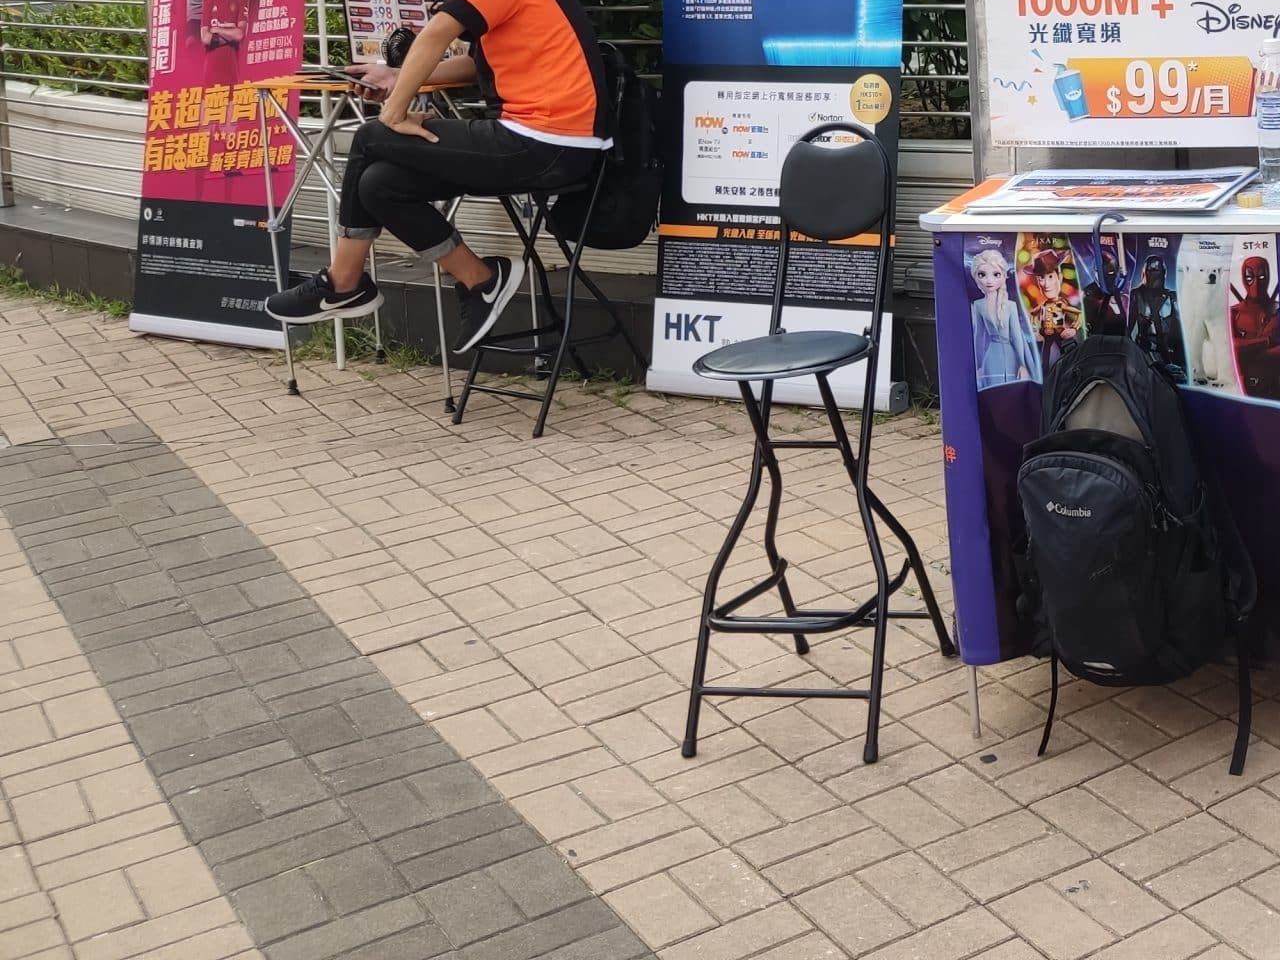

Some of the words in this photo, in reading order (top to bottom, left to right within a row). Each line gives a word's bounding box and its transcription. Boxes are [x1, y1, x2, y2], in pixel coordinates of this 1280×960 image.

[1028, 22, 1122, 44] 光纖寬頻
[817, 113, 842, 121] Norton
[144, 132, 210, 171] 有話題
[665, 313, 722, 343] HKT
[1054, 502, 1092, 518] Columbia
